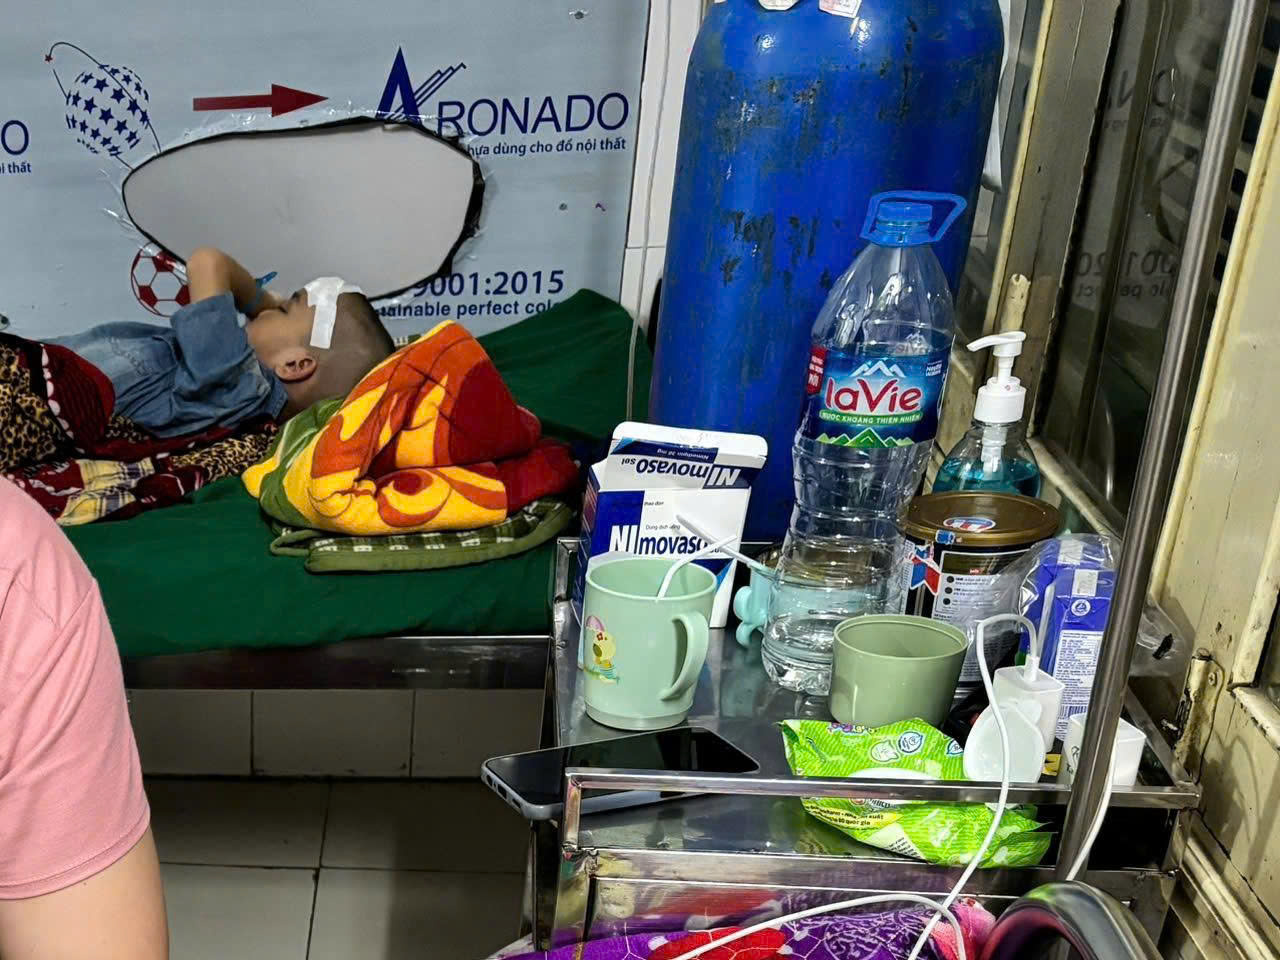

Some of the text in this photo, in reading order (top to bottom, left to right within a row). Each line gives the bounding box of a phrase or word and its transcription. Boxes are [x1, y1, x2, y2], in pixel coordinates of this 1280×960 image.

[493, 142, 526, 156] dùng
[529, 139, 553, 153] cho
[576, 139, 597, 153] nội
[599, 137, 626, 150] thất
[7, 161, 32, 174] thất
[456, 300, 520, 319] perfect
